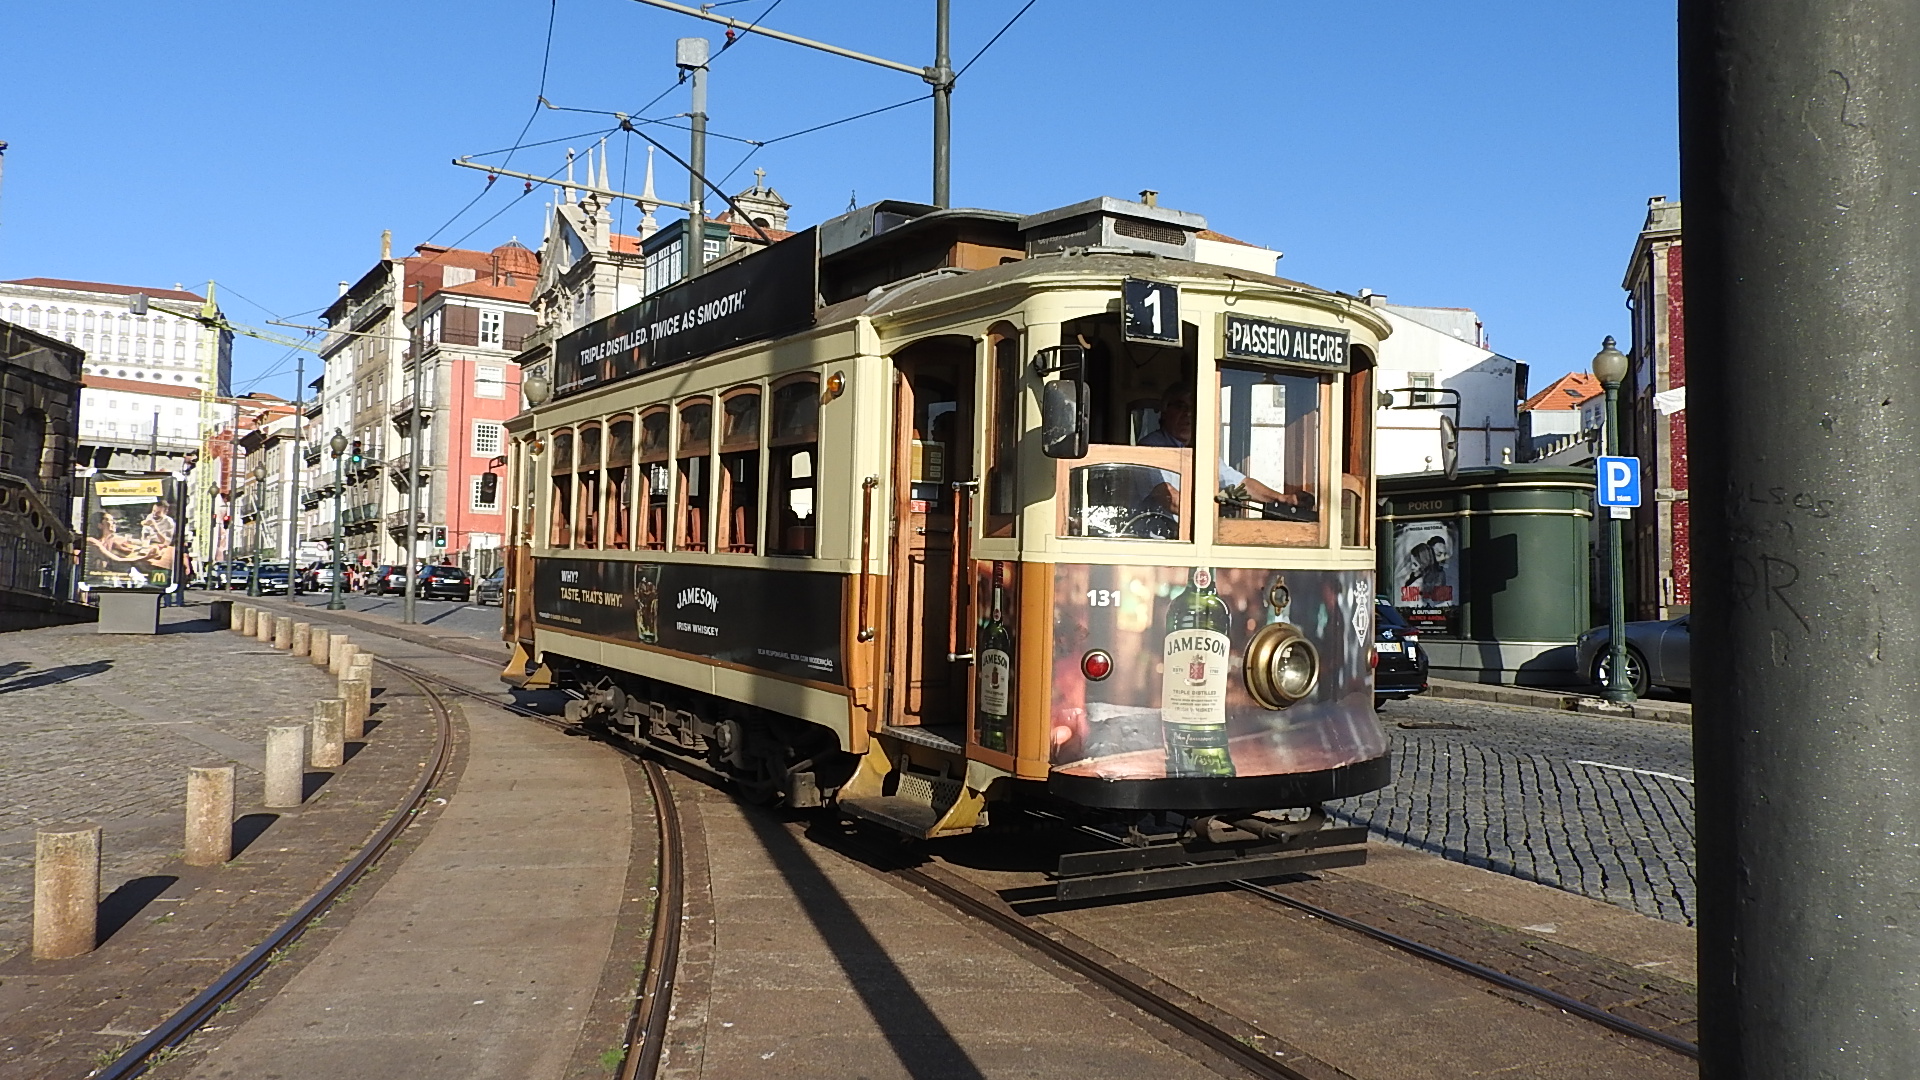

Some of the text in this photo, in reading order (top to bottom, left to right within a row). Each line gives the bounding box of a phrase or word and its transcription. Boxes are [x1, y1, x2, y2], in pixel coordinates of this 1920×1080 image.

[1144, 289, 1161, 334] 1
[580, 343, 605, 366] TRIPLE
[606, 328, 648, 357] DISTILLED.
[650, 315, 680, 341] TWICE
[681, 308, 695, 331] AS
[1232, 321, 1343, 364] PASSEIO ALEGRE
[1606, 461, 1631, 502] P
[1408, 500, 1443, 510] PORTO
[561, 570, 579, 583] WHY?
[560, 587, 580, 603] TASTE,
[582, 589, 602, 605] THAT'S
[677, 587, 719, 612] JAMESON
[1086, 589, 1121, 607] 131
[676, 621, 719, 637] IRISH WHISKEY
[1167, 637, 1227, 658] JAMESON
[983, 654, 1007, 669] JAMESON
